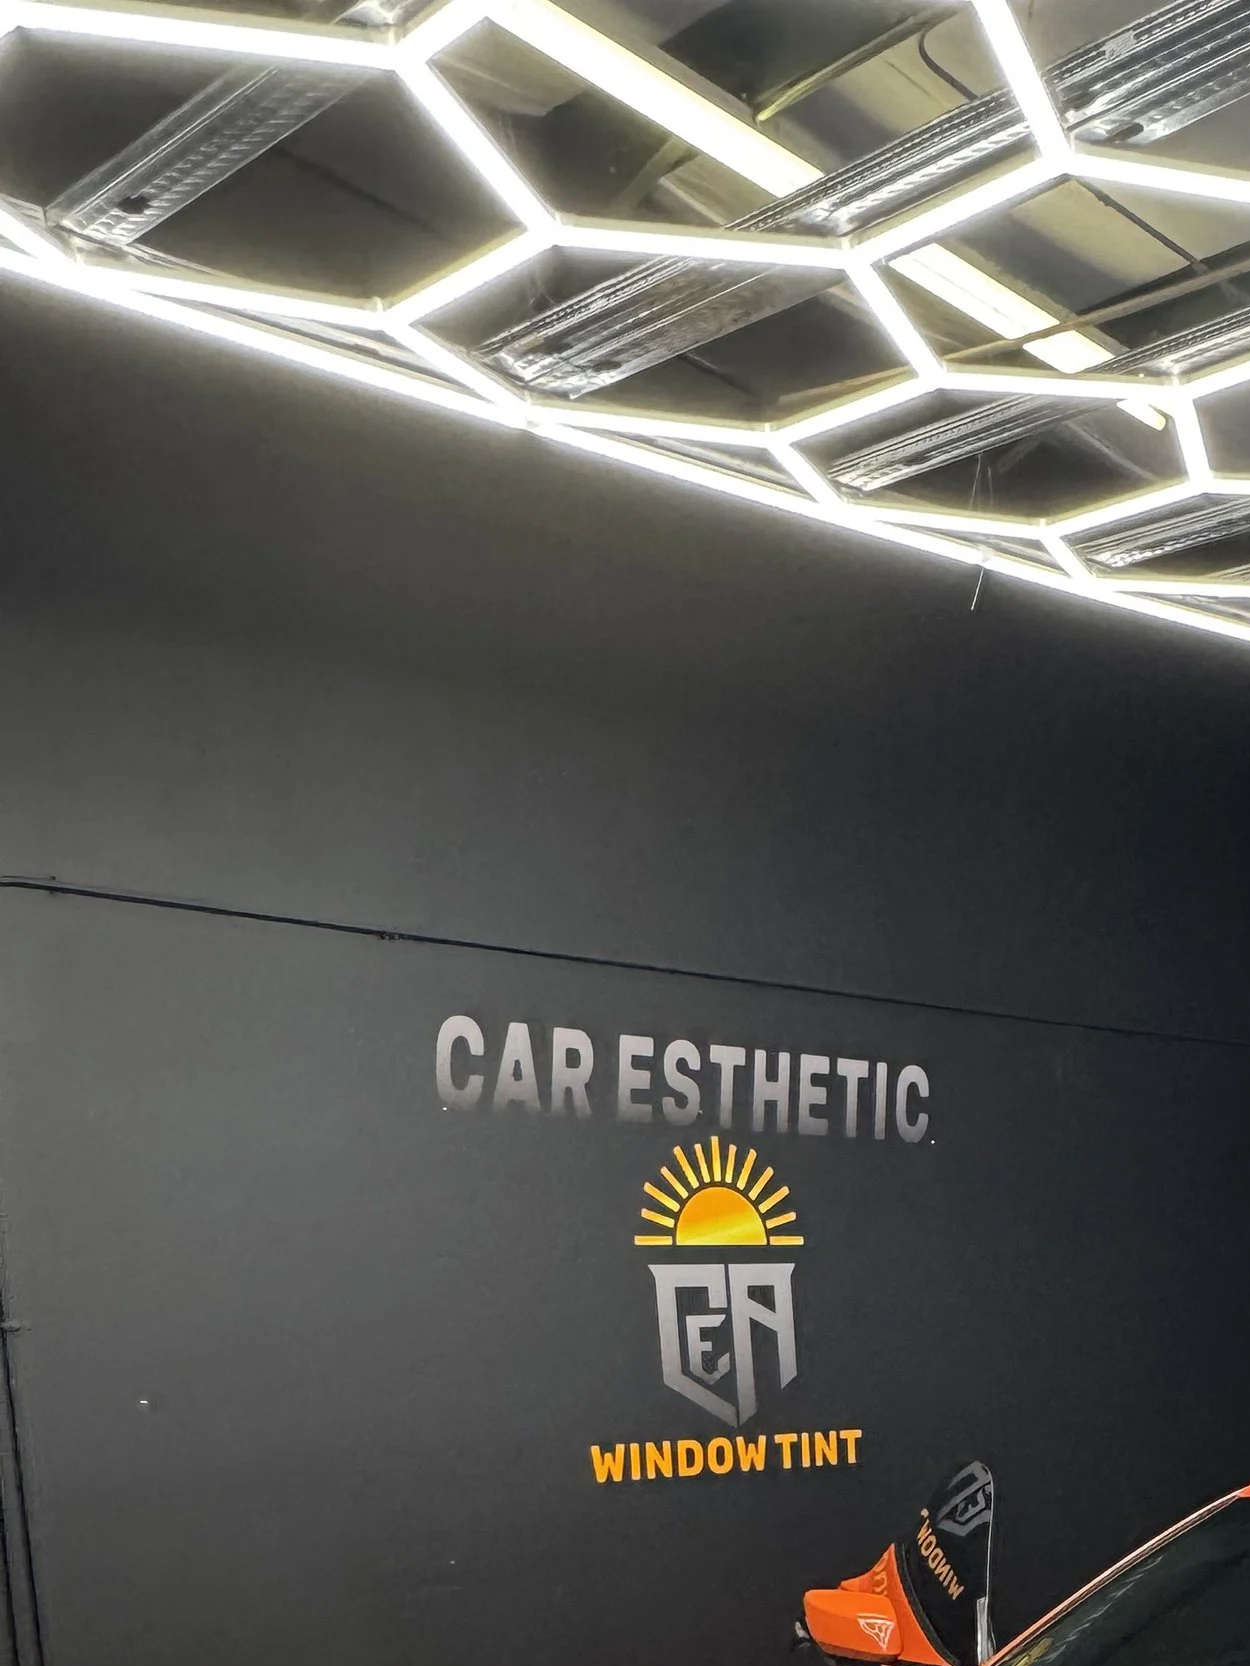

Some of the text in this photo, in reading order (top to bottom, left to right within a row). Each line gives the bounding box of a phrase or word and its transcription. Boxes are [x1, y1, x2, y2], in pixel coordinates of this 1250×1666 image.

[436, 1015, 931, 1144] CAR ESTHETIC
[590, 1429, 862, 1483] WINDOW TINT
